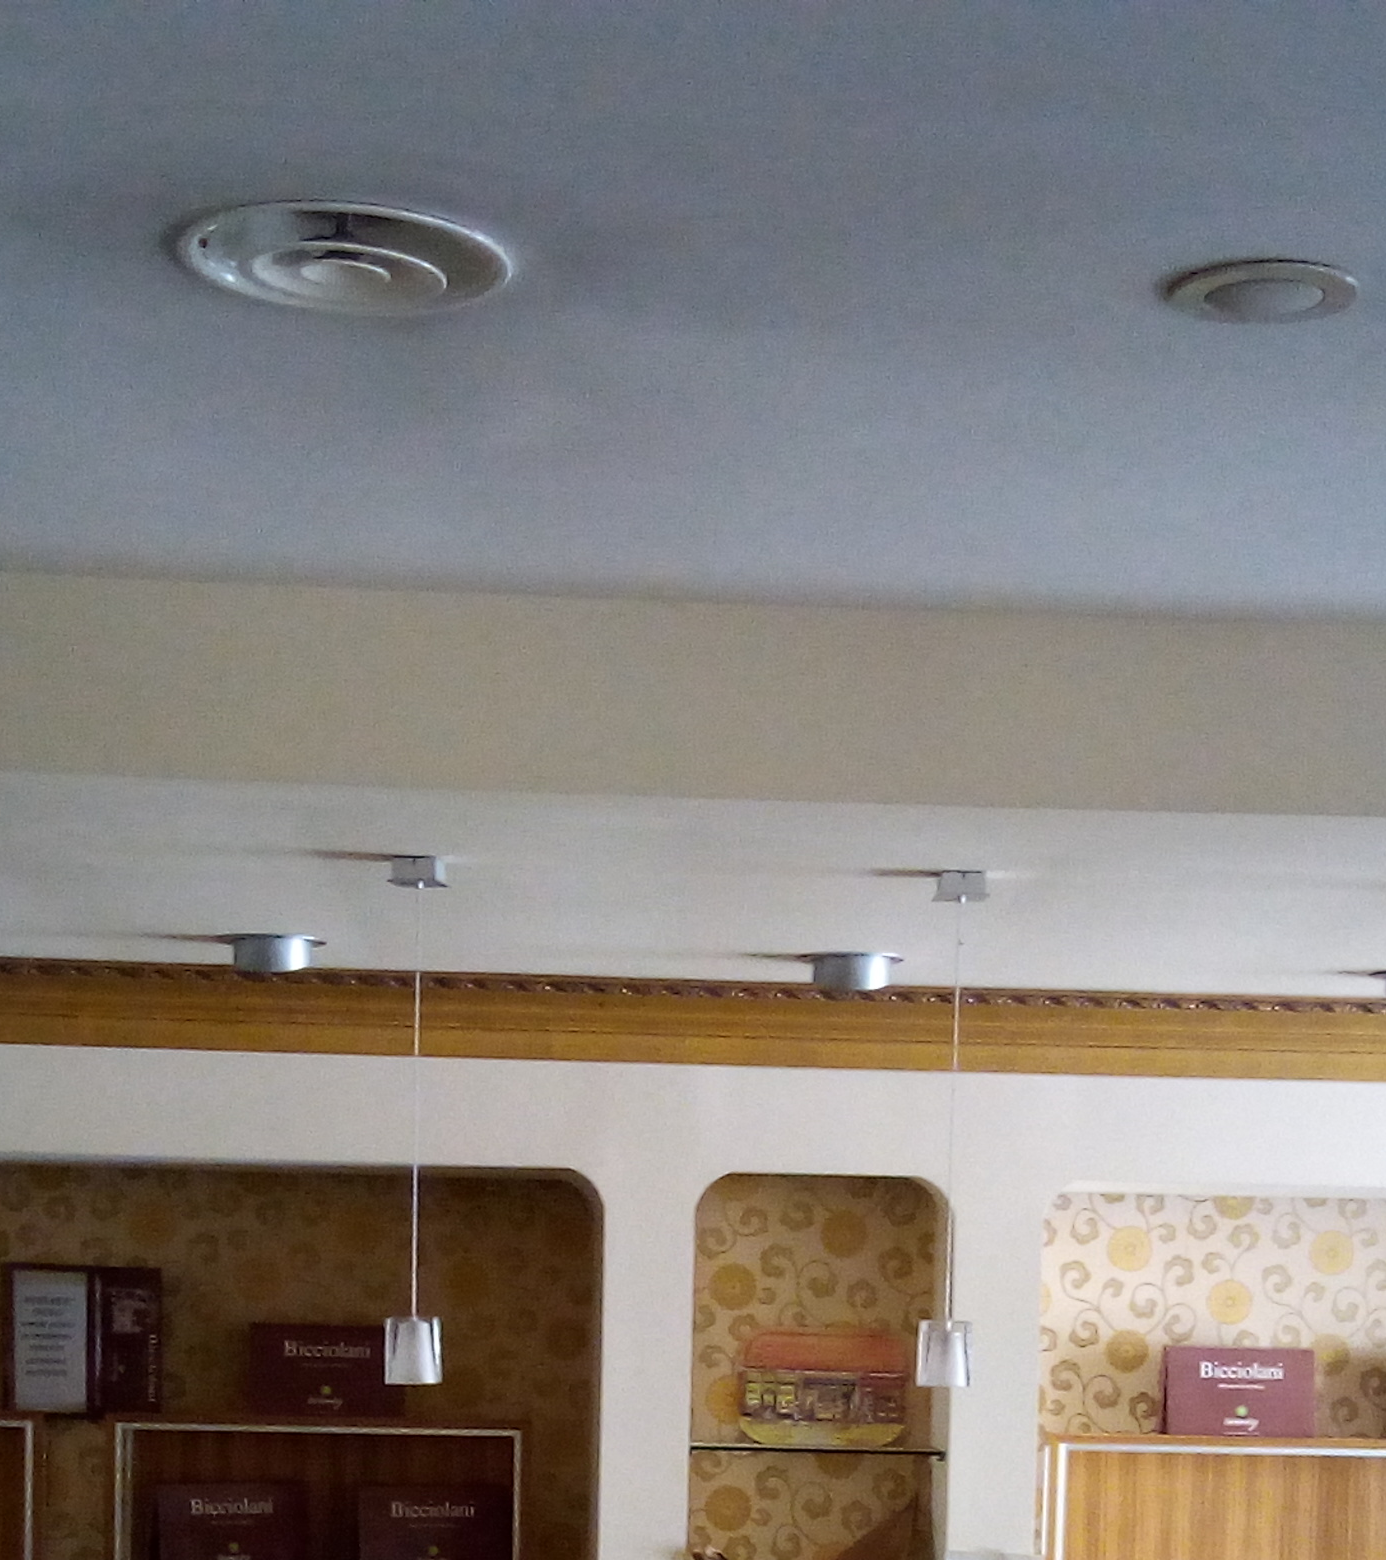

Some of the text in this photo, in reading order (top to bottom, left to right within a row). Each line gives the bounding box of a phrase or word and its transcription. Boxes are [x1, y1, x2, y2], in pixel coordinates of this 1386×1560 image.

[284, 1339, 371, 1359] Bicciolani
[1199, 1361, 1285, 1381] Bicciolani
[190, 1497, 274, 1516] Bicciolani
[390, 1500, 476, 1518] Bicciolani
